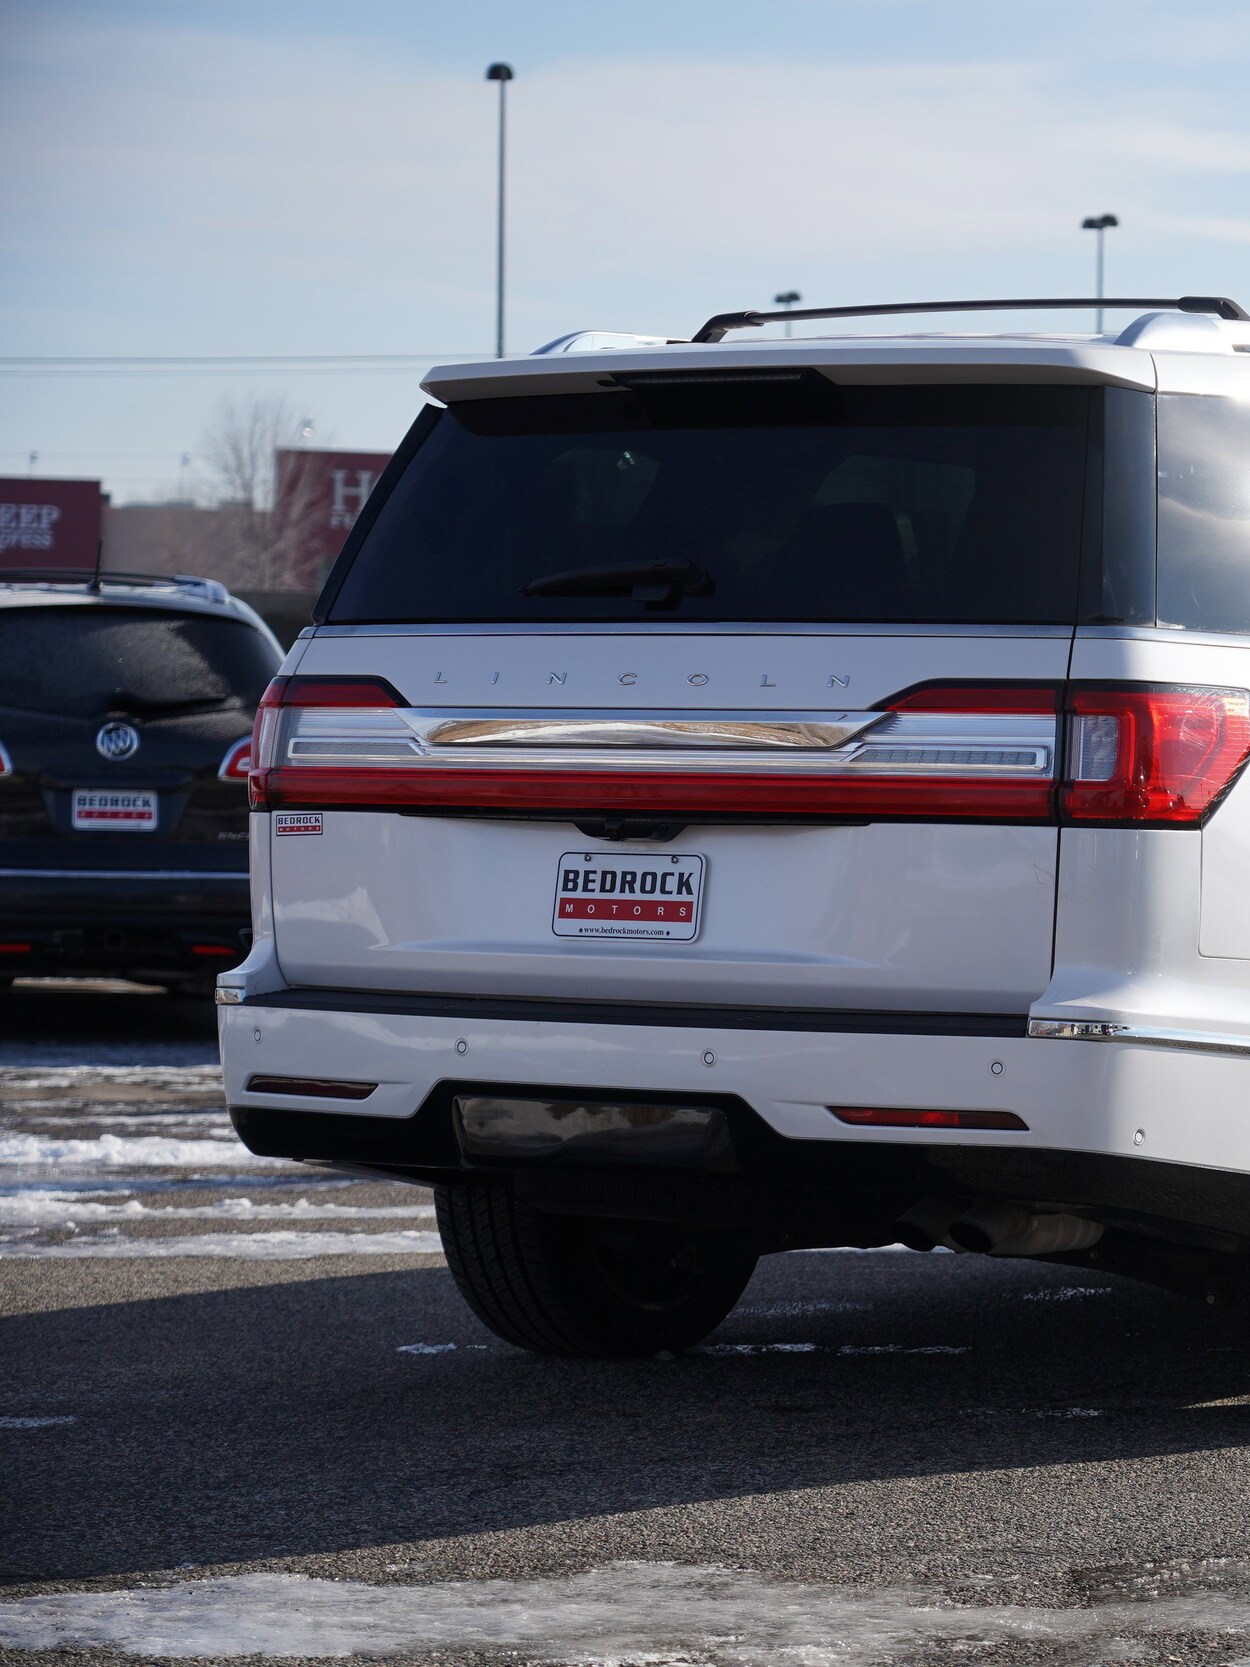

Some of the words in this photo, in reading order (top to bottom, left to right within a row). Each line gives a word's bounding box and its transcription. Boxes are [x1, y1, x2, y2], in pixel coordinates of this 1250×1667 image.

[434, 671, 851, 689] LINCOLN
[77, 795, 152, 808] BEDROCK
[278, 816, 320, 825] BEDROCK
[561, 869, 694, 895] BEDROCK
[565, 903, 686, 917] MOTORS
[584, 926, 664, 936] www.bedrockmotors.com
